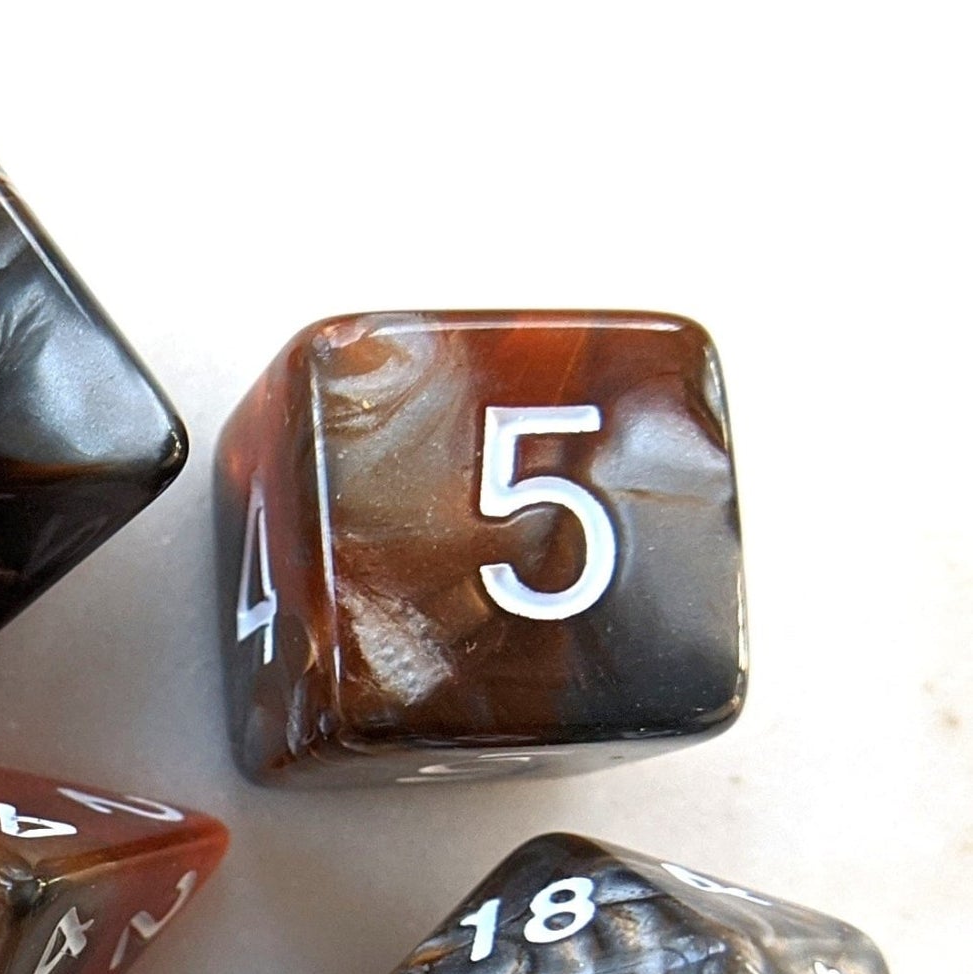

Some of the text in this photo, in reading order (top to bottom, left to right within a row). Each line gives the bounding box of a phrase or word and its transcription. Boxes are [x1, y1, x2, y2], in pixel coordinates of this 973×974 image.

[236, 478, 277, 665] 4
[480, 405, 617, 620] 5
[109, 870, 197, 970] 2
[461, 877, 595, 961] 18
